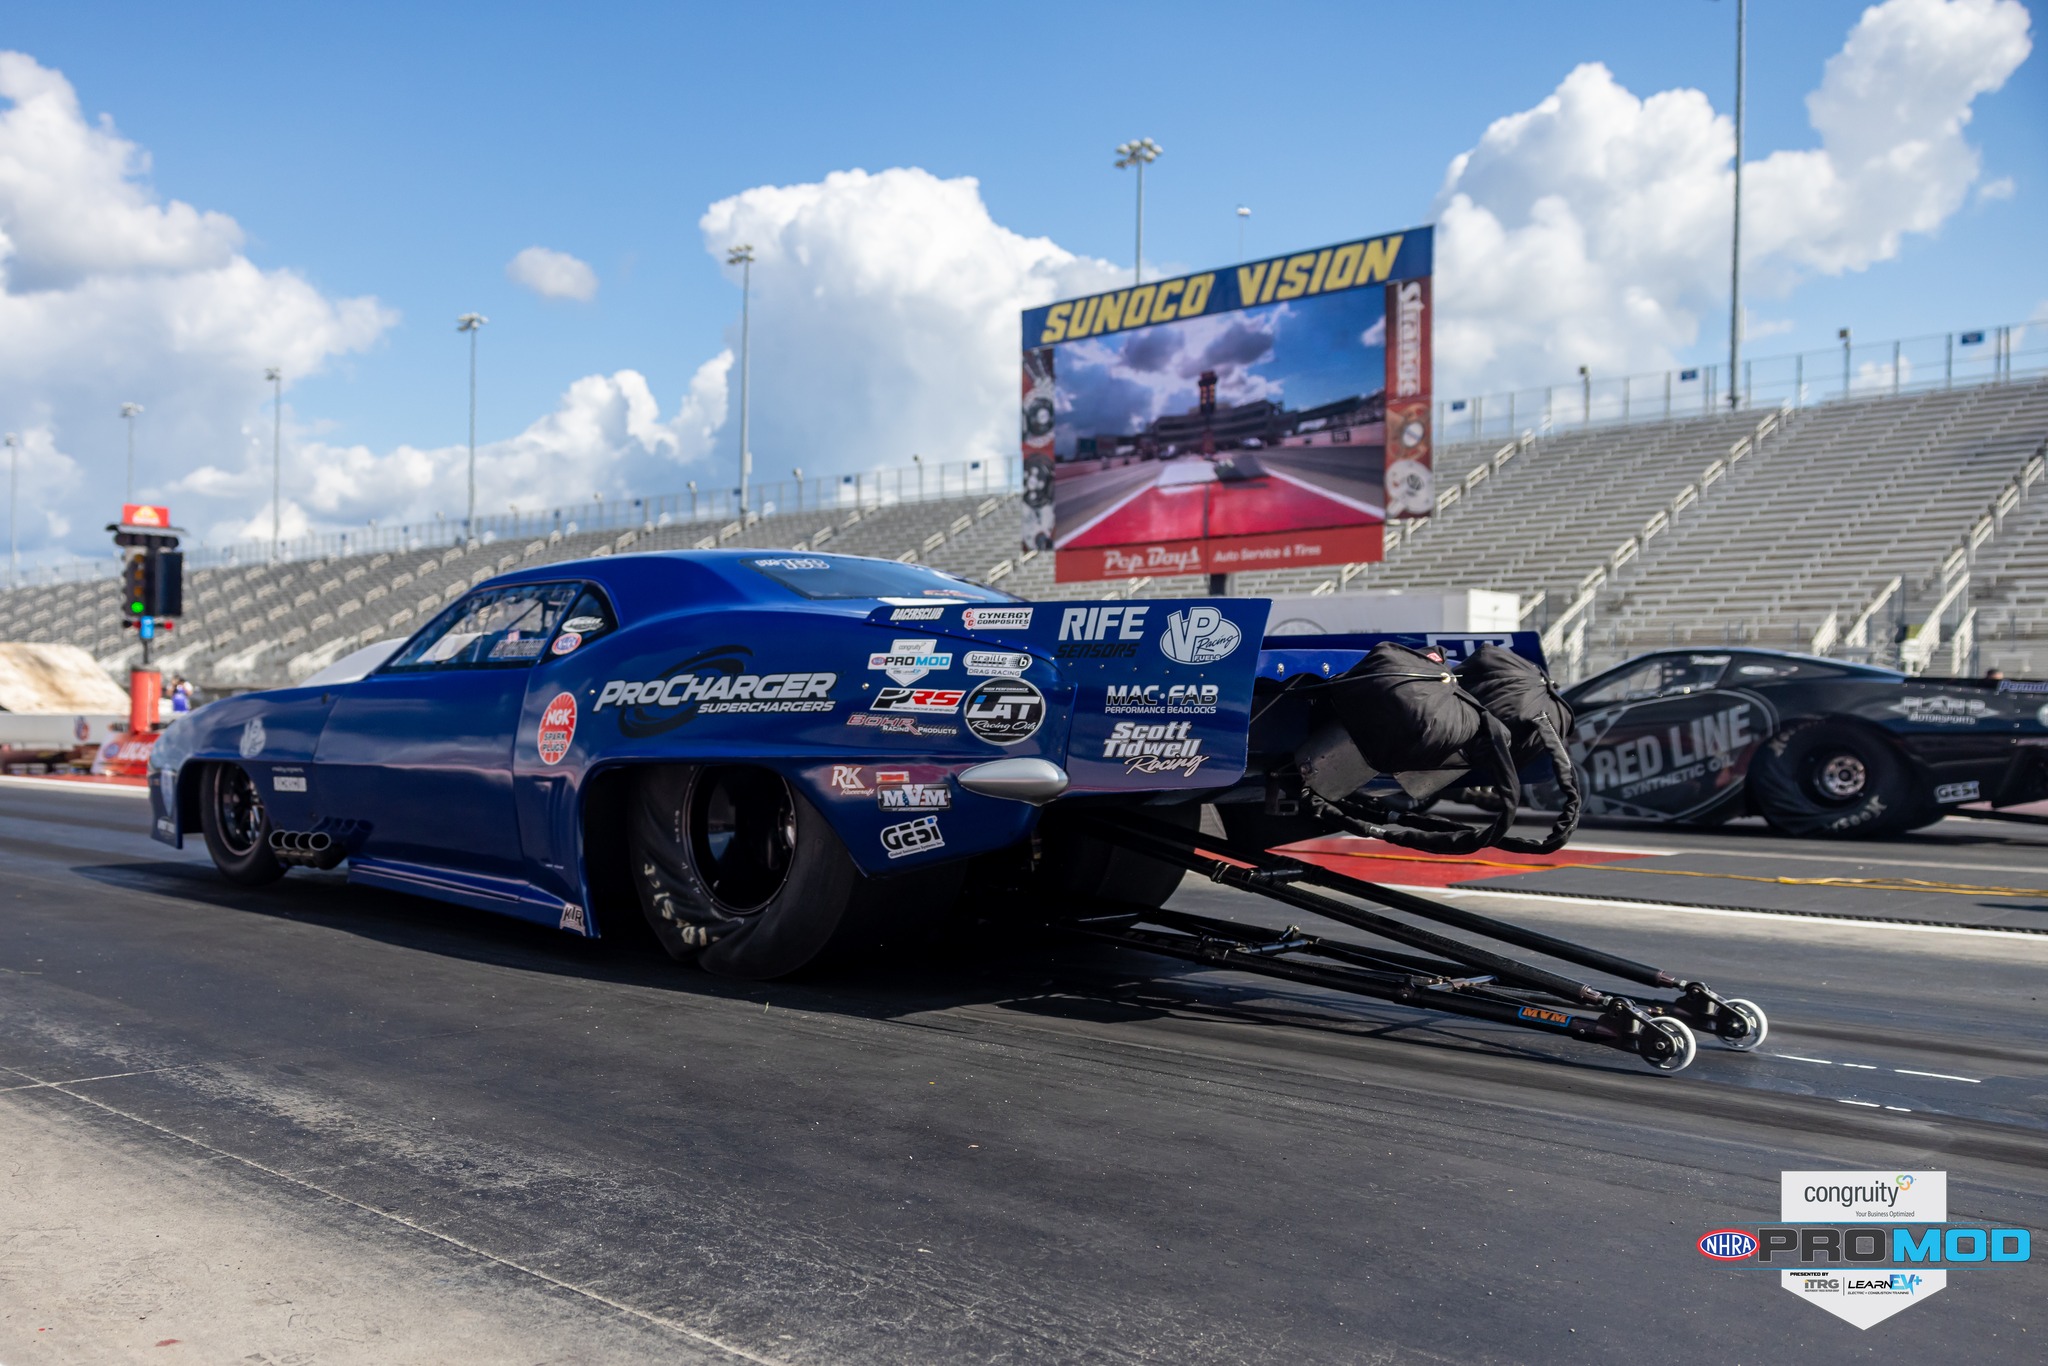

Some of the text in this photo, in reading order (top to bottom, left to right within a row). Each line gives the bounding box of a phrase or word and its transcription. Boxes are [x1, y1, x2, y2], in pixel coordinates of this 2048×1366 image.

[1041, 236, 1404, 343] SUNOCO VISION
[1104, 546, 1199, 573] Pep Boys
[1214, 551, 1239, 563] Auto
[1241, 547, 1280, 560] Service
[1295, 544, 1321, 556] Tires
[890, 608, 944, 621] RACERSCLUB
[979, 611, 1030, 619] CYNERGY
[1058, 606, 1150, 641] RIFE
[1167, 607, 1222, 663] VP
[1055, 643, 1140, 659] SENSORS
[1196, 635, 1240, 654] Racing
[971, 654, 1007, 662] braille
[1194, 654, 1221, 662] FUELS
[991, 669, 1020, 677] RACING
[697, 701, 836, 713] SUPERCHARGERS
[966, 695, 1041, 720] LAT
[1105, 706, 1216, 714] PERFORMANCE BEADLOCKS
[545, 708, 572, 726] NGK
[847, 714, 921, 735] BOHR
[971, 720, 1036, 732] Racing Oils
[1909, 712, 1976, 724] MOTORSPORTS
[544, 732, 567, 740] SPARK
[918, 727, 957, 735] PRODUCTS
[1111, 721, 1192, 740] Scott
[542, 743, 565, 752] PLUGS
[1103, 738, 1202, 758] Tidwell
[1592, 735, 1664, 792] RED
[1668, 703, 1752, 767] LINE
[1124, 754, 1209, 777] Racing
[832, 766, 865, 788] RK
[1621, 756, 1735, 799] SYNTHETIC OIL
[882, 784, 947, 806] MVM
[1522, 1007, 1567, 1023] MVM
